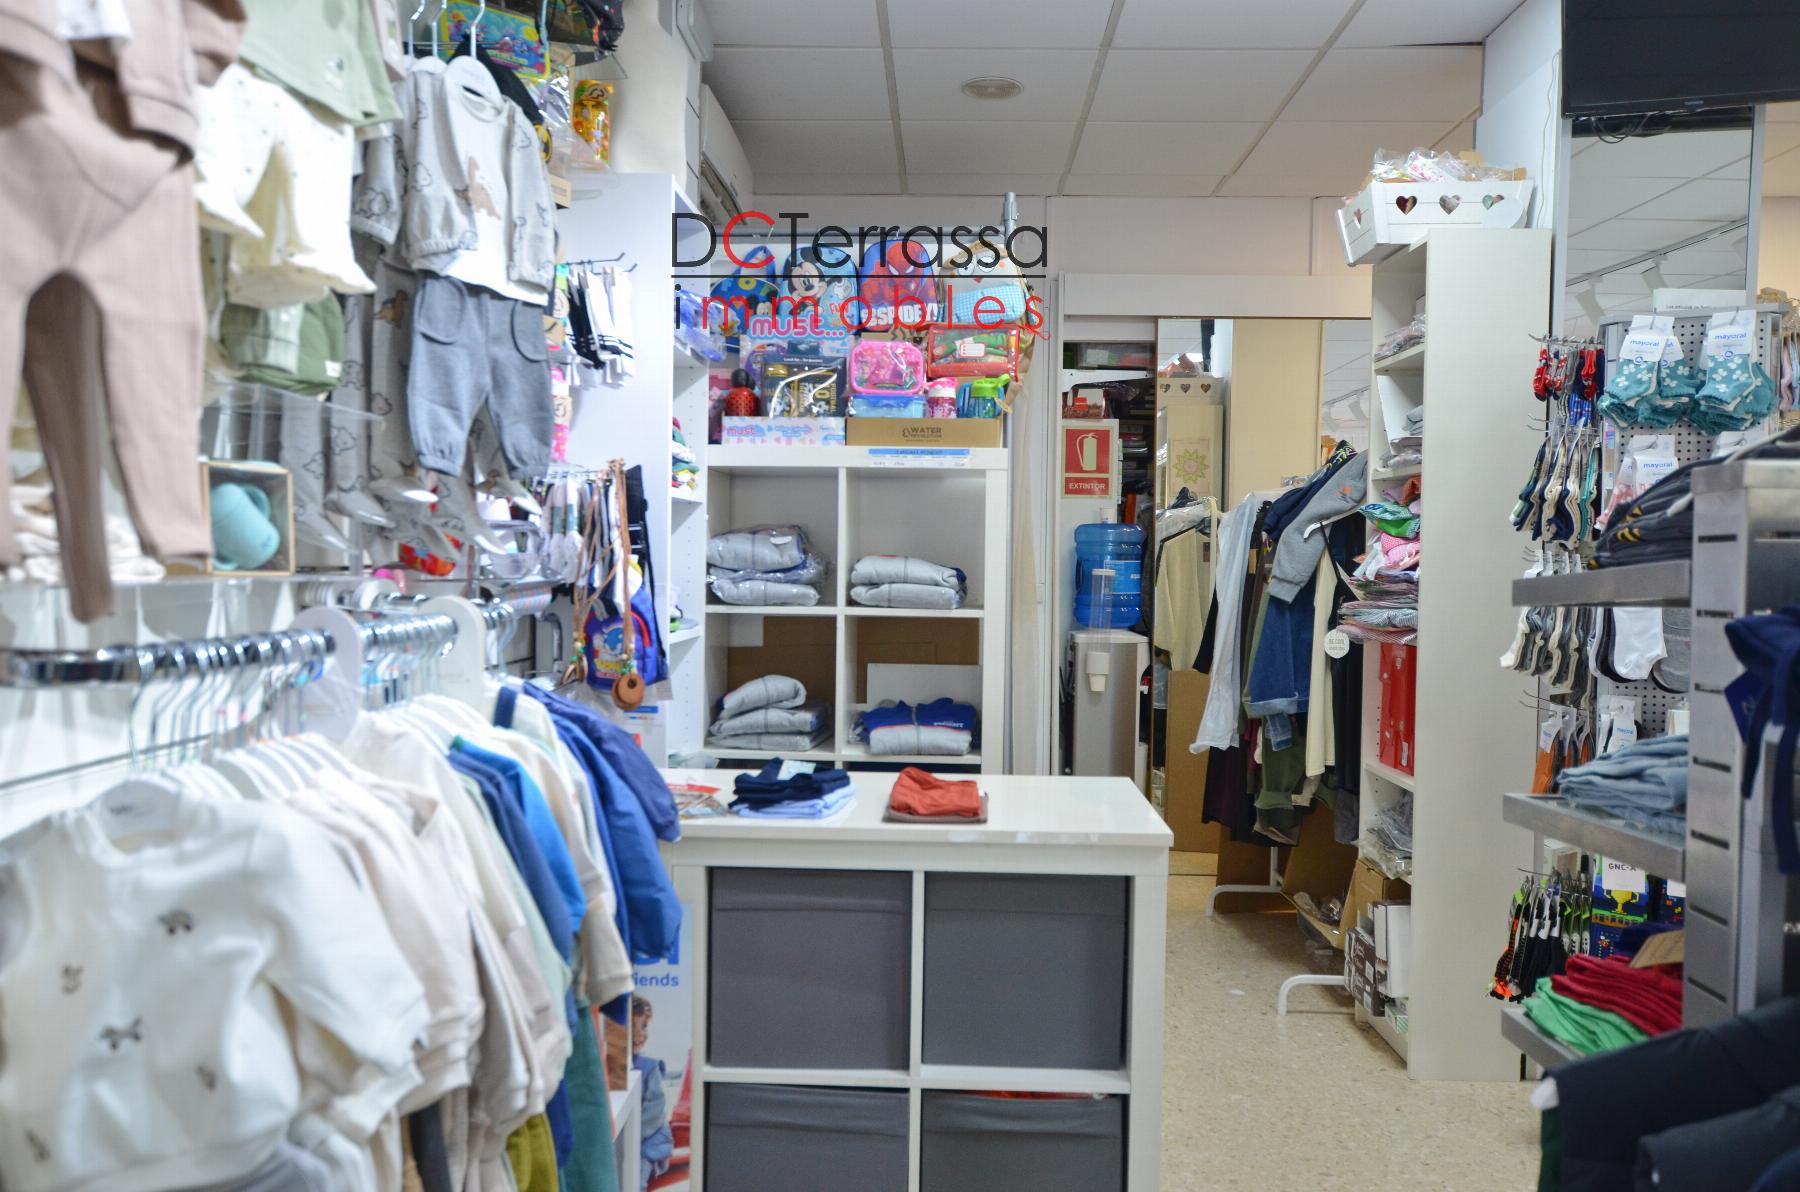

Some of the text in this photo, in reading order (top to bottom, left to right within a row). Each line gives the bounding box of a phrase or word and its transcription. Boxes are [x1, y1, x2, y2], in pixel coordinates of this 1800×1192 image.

[1713, 332, 1748, 342] mayoral
[1629, 339, 1660, 348] mayoral
[1069, 482, 1105, 490] EXTINTOR
[633, 972, 679, 987] iends
